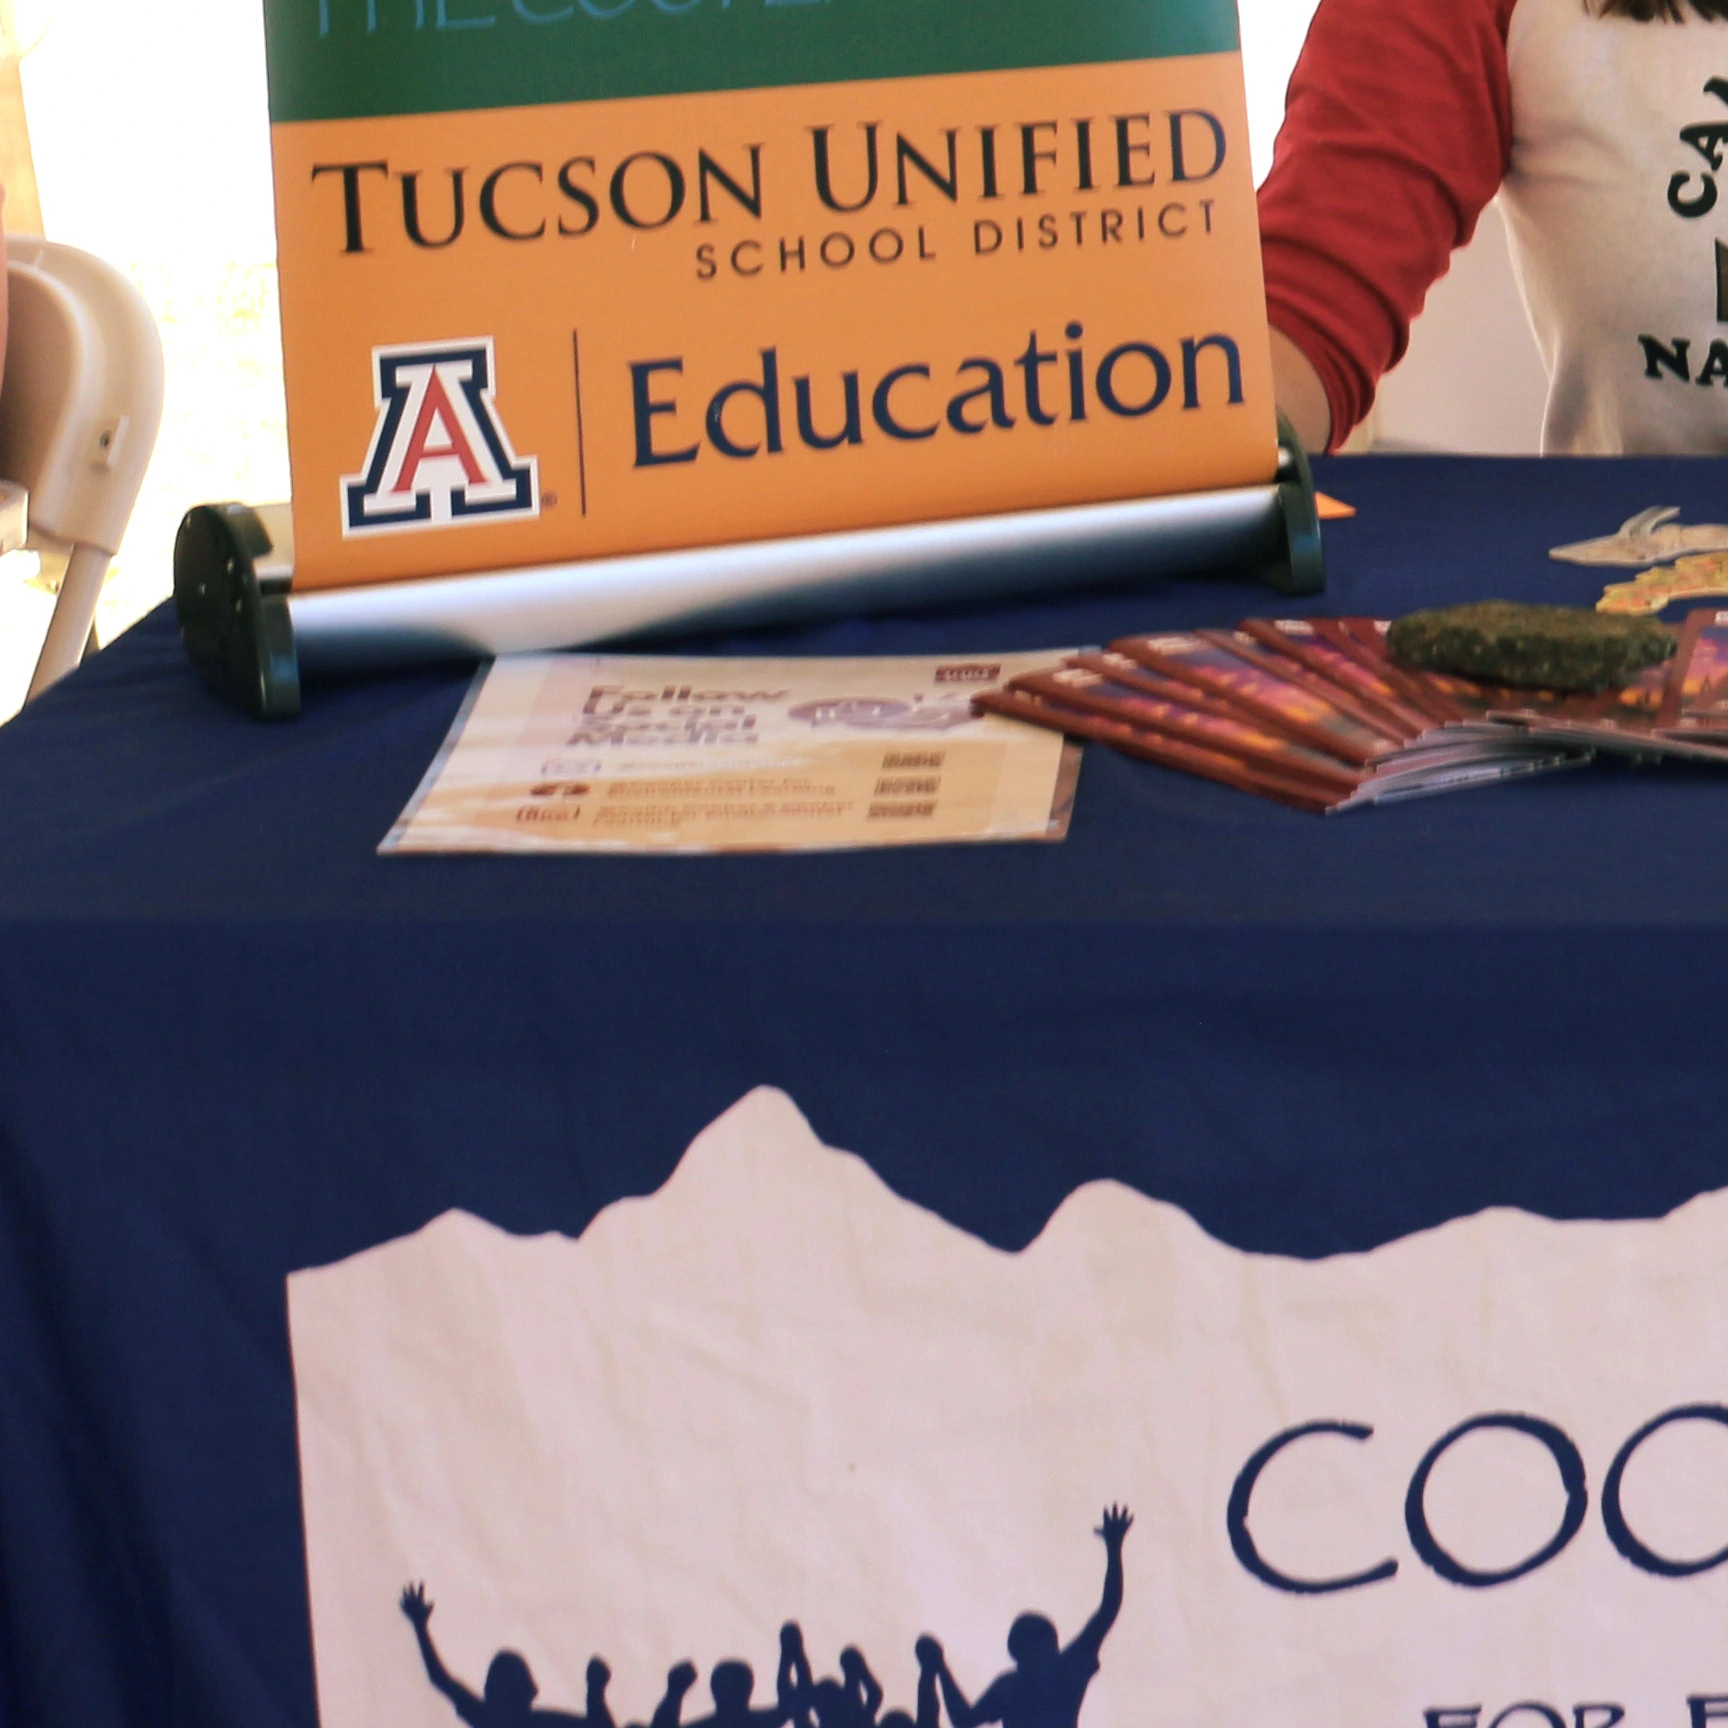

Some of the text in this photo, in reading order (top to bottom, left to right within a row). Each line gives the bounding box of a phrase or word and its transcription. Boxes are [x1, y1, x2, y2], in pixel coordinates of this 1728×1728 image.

[311, 108, 1227, 254] TUCSON UNIFIED
[695, 198, 1218, 281] SCHOOL DISTRICT
[627, 320, 1244, 468] Education
[591, 684, 793, 702] Follow
[567, 728, 759, 748] Media
